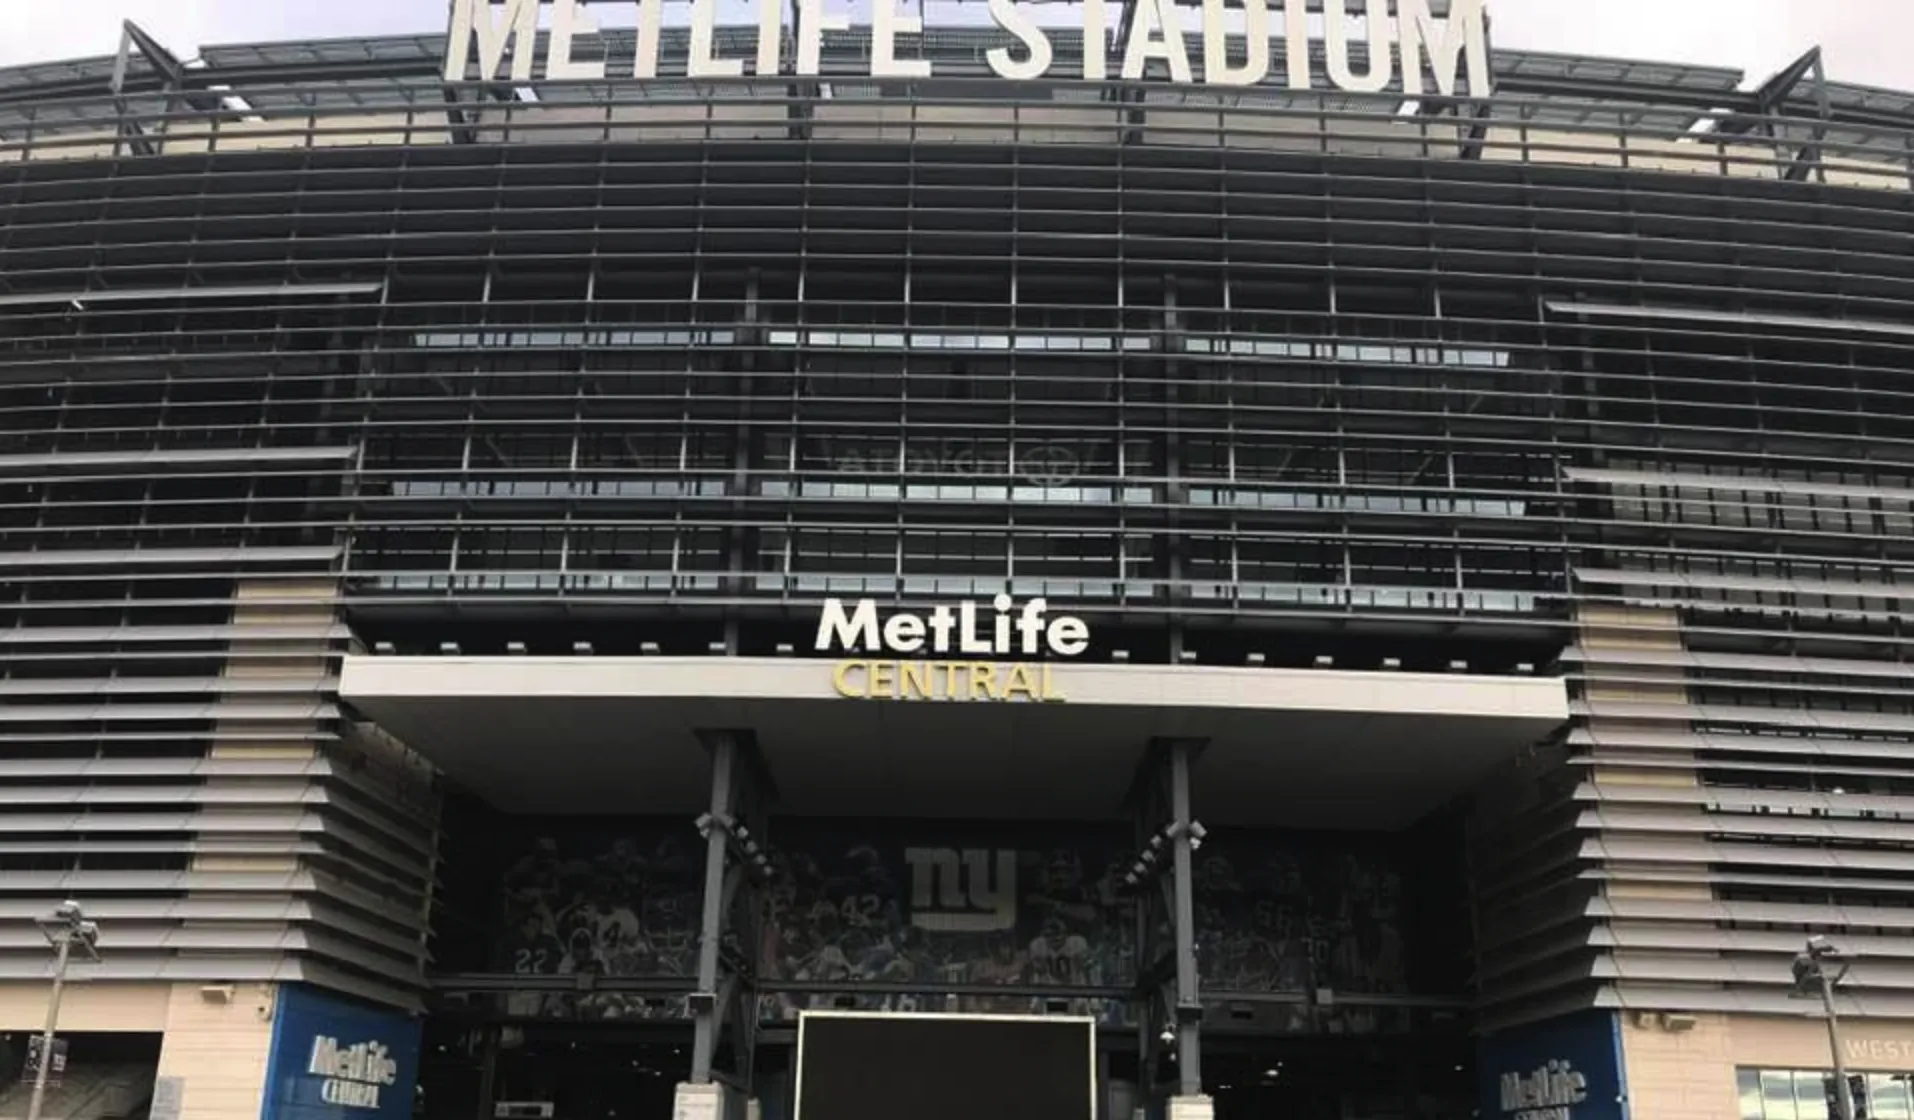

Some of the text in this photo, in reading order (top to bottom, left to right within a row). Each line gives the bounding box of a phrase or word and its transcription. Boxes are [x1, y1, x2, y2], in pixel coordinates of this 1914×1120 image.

[445, 0, 1491, 98] METLIFE STADIUM
[814, 593, 1090, 655] MetLife
[832, 659, 1065, 702] CENTRAL
[904, 845, 1018, 931] ny
[514, 947, 549, 974] 22
[308, 1034, 397, 1086] MetLife
[1845, 1039, 1914, 1060] WEST
[321, 1079, 381, 1109] CENTRAL
[1500, 1058, 1588, 1112] MetLife
